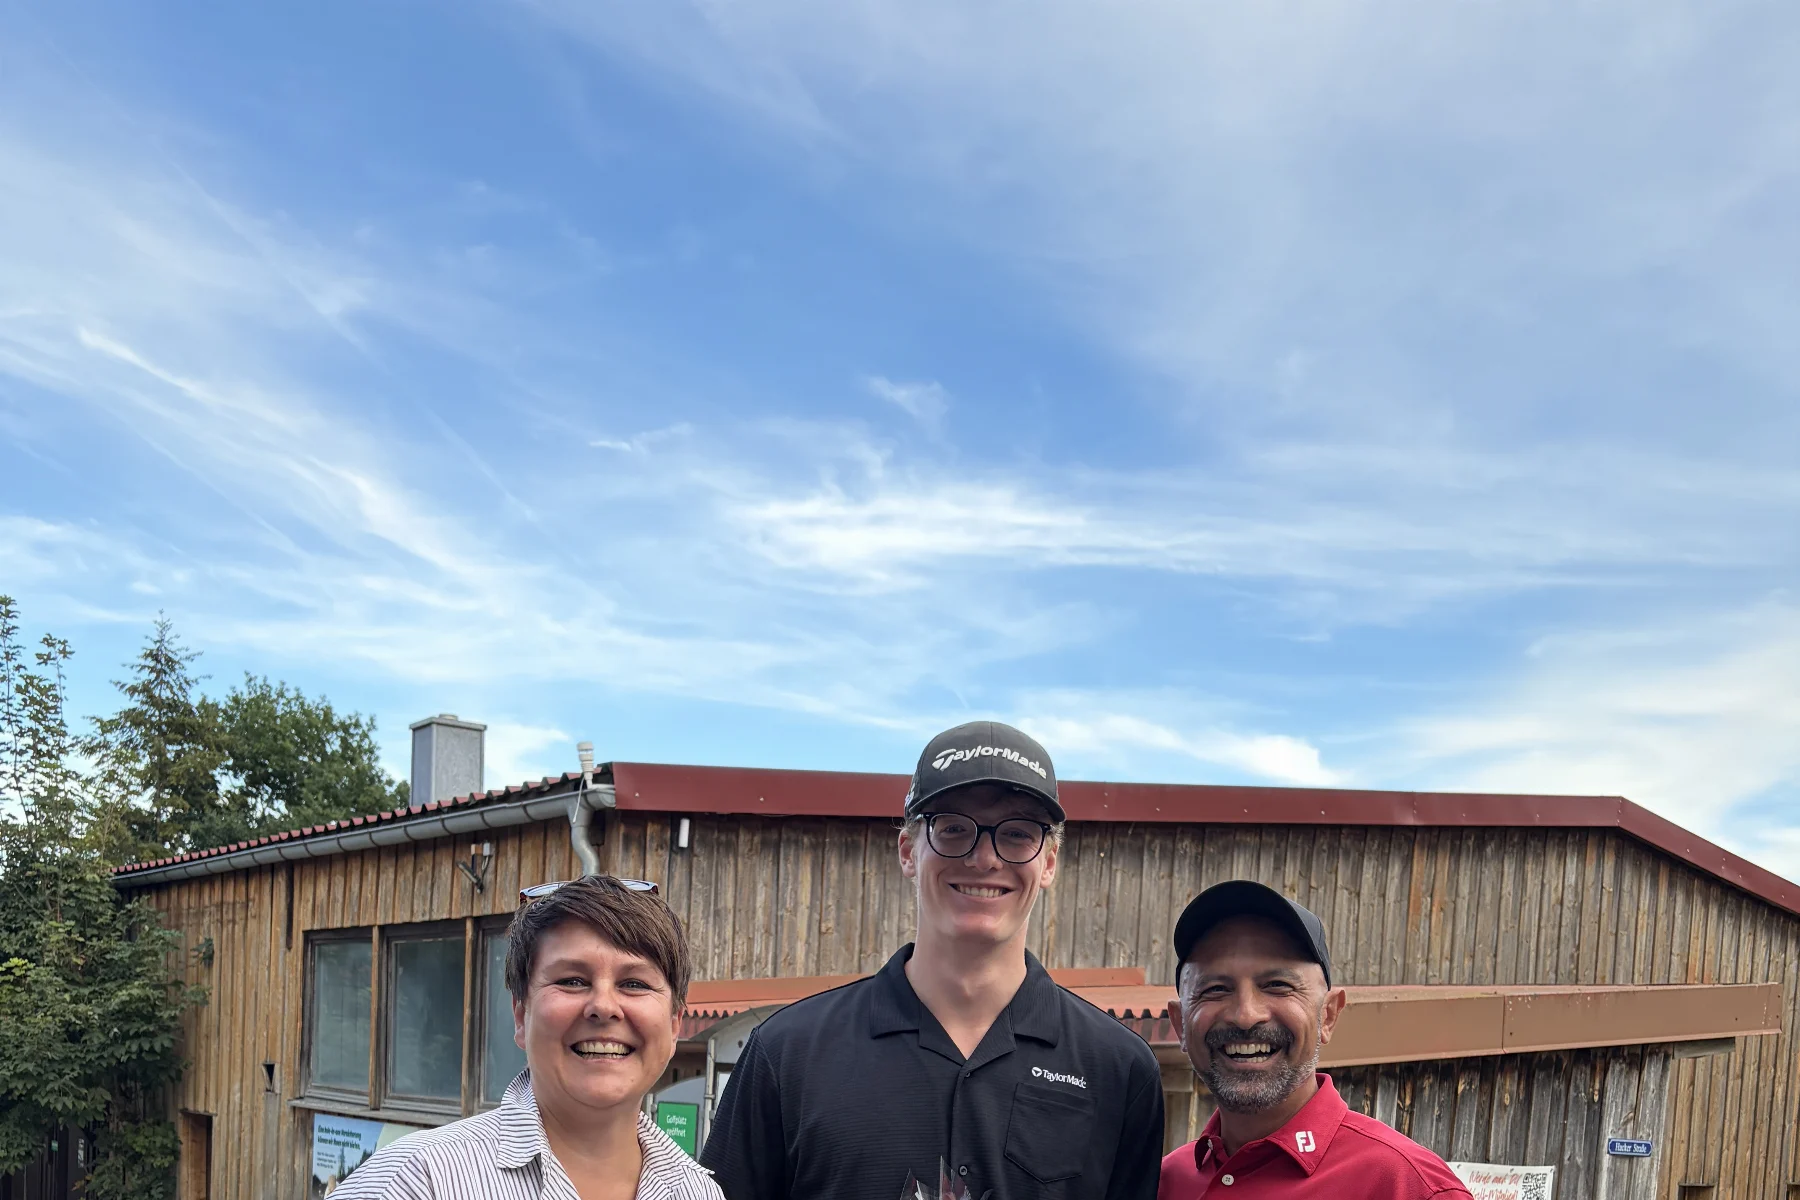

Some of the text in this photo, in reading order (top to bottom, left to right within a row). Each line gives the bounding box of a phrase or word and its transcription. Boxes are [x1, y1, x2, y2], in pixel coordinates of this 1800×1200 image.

[932, 745, 1047, 780] TaylorMade
[1042, 1069, 1087, 1089] TaylorMade
[666, 1114, 687, 1125] Golfplatz
